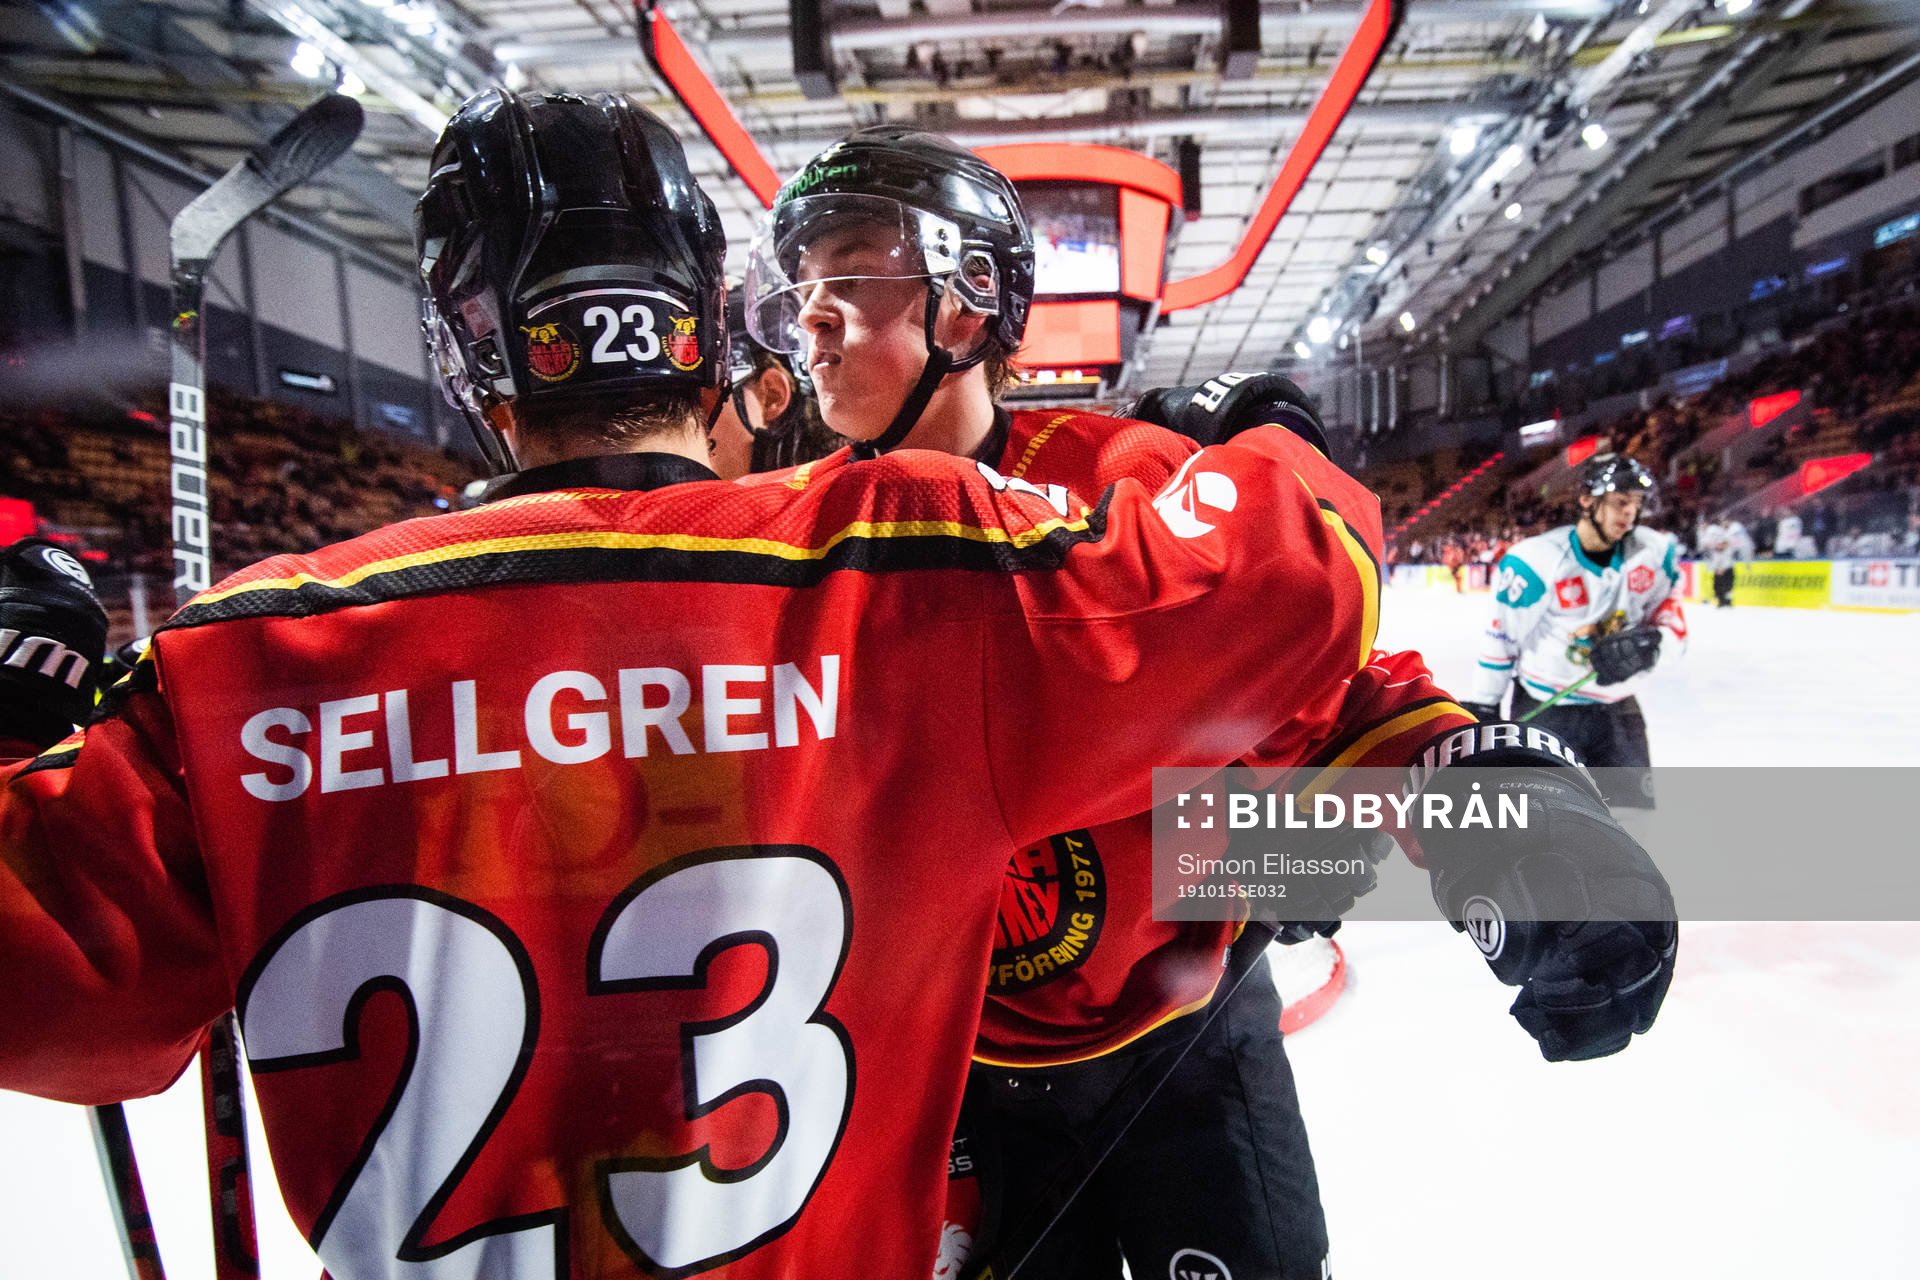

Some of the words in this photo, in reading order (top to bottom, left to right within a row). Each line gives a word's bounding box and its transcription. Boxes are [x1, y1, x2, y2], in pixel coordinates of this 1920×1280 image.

[583, 305, 660, 363] 23
[240, 654, 841, 802] SELLGREN
[1064, 836, 1096, 902] 1977
[235, 843, 858, 1280] 23
